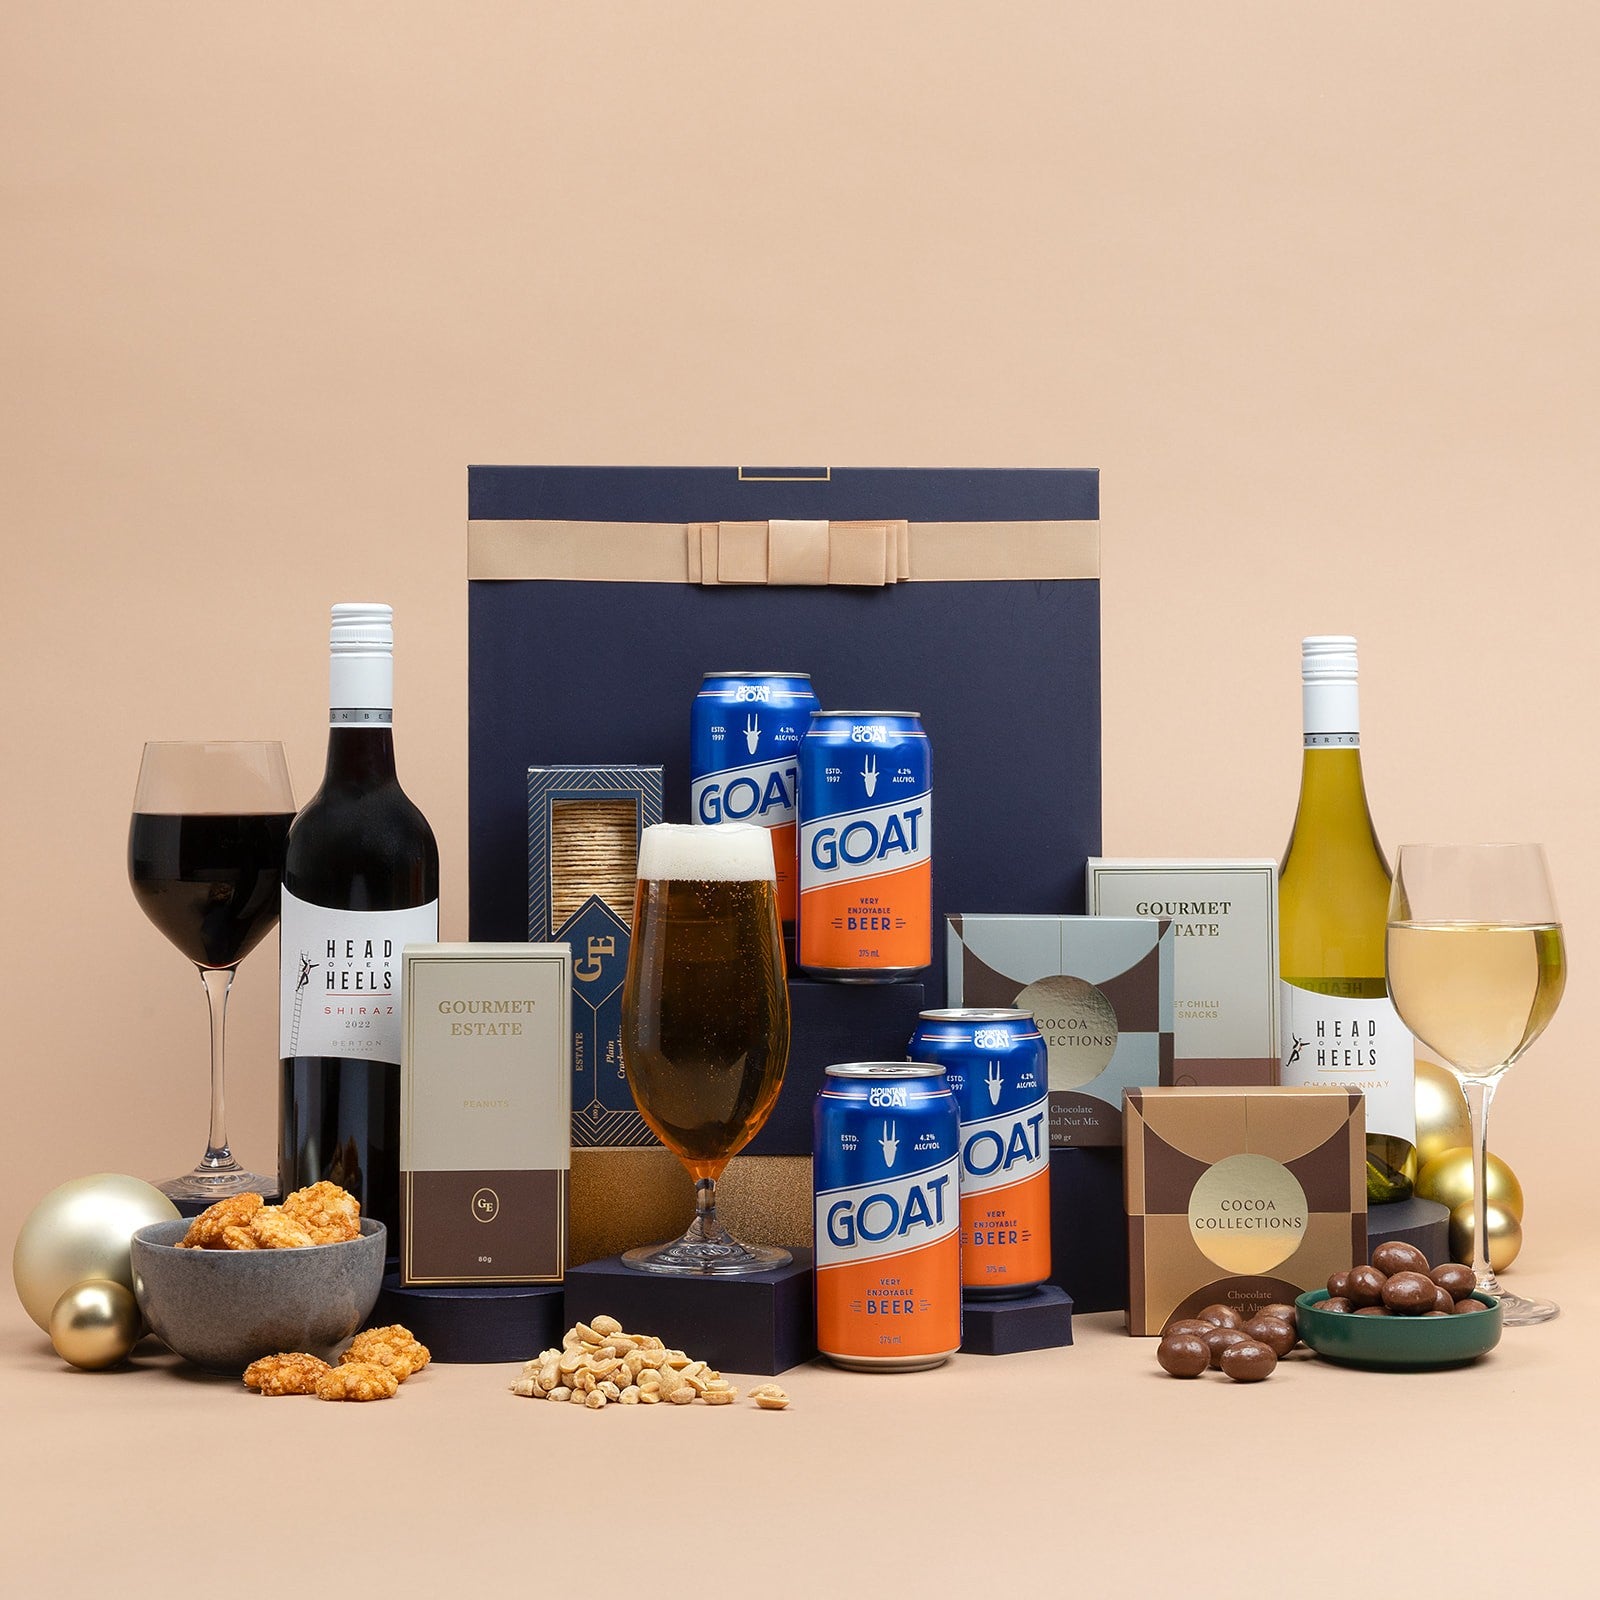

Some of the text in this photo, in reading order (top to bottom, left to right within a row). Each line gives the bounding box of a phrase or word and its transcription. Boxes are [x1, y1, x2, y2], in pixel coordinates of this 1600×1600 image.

[736, 692, 770, 702] GOAT
[852, 731, 887, 742] GOAT
[811, 806, 923, 871] GOAT
[1135, 901, 1232, 916] GOURMET
[847, 917, 891, 930] BEER
[1174, 923, 1219, 936] TATE
[326, 939, 393, 959] HEAD
[858, 949, 869, 957] 375
[326, 971, 393, 990] HEELS
[438, 1000, 536, 1014] GOURMET
[1187, 1000, 1220, 1008] CHILLI
[324, 1006, 394, 1015] SHIRAZ
[1178, 1010, 1218, 1018] SNACKS
[345, 1021, 371, 1029] 2022
[451, 1022, 523, 1036] ESTATE
[1035, 1018, 1088, 1030] COCOA
[1316, 1020, 1377, 1038] HEAD
[974, 1036, 1010, 1049] GOAT
[1049, 1035, 1113, 1047] ECTIONS
[575, 1032, 584, 1072] ESTATE
[606, 1040, 614, 1064] Plain
[1317, 1048, 1377, 1066] HEELS
[870, 1087, 907, 1095] MOUNTAIN
[463, 1100, 510, 1108] PEANUTS
[869, 1094, 907, 1107] GOAT
[1050, 1104, 1093, 1113] Chocolate
[1049, 1117, 1100, 1125] nd Nut Mix
[841, 1134, 859, 1142] ESTD.
[1051, 1133, 1062, 1141] 100
[914, 1142, 940, 1151] ALC/VOL
[962, 1111, 1044, 1177] OAT
[477, 1198, 494, 1213] GE
[826, 1173, 949, 1248] GOAT
[1220, 1199, 1276, 1211] COCOA
[986, 1210, 1006, 1218] VERY
[973, 1220, 1018, 1228] ENJOYABLE
[1195, 1217, 1302, 1229] COLLECTIONS
[974, 1230, 1018, 1245] BEER
[478, 1256, 492, 1264] 80g
[986, 1265, 997, 1273] 375
[880, 1278, 901, 1286] VERY
[1227, 1290, 1272, 1299] Chocolate
[866, 1300, 914, 1315] BEER
[879, 1336, 890, 1344] 375
